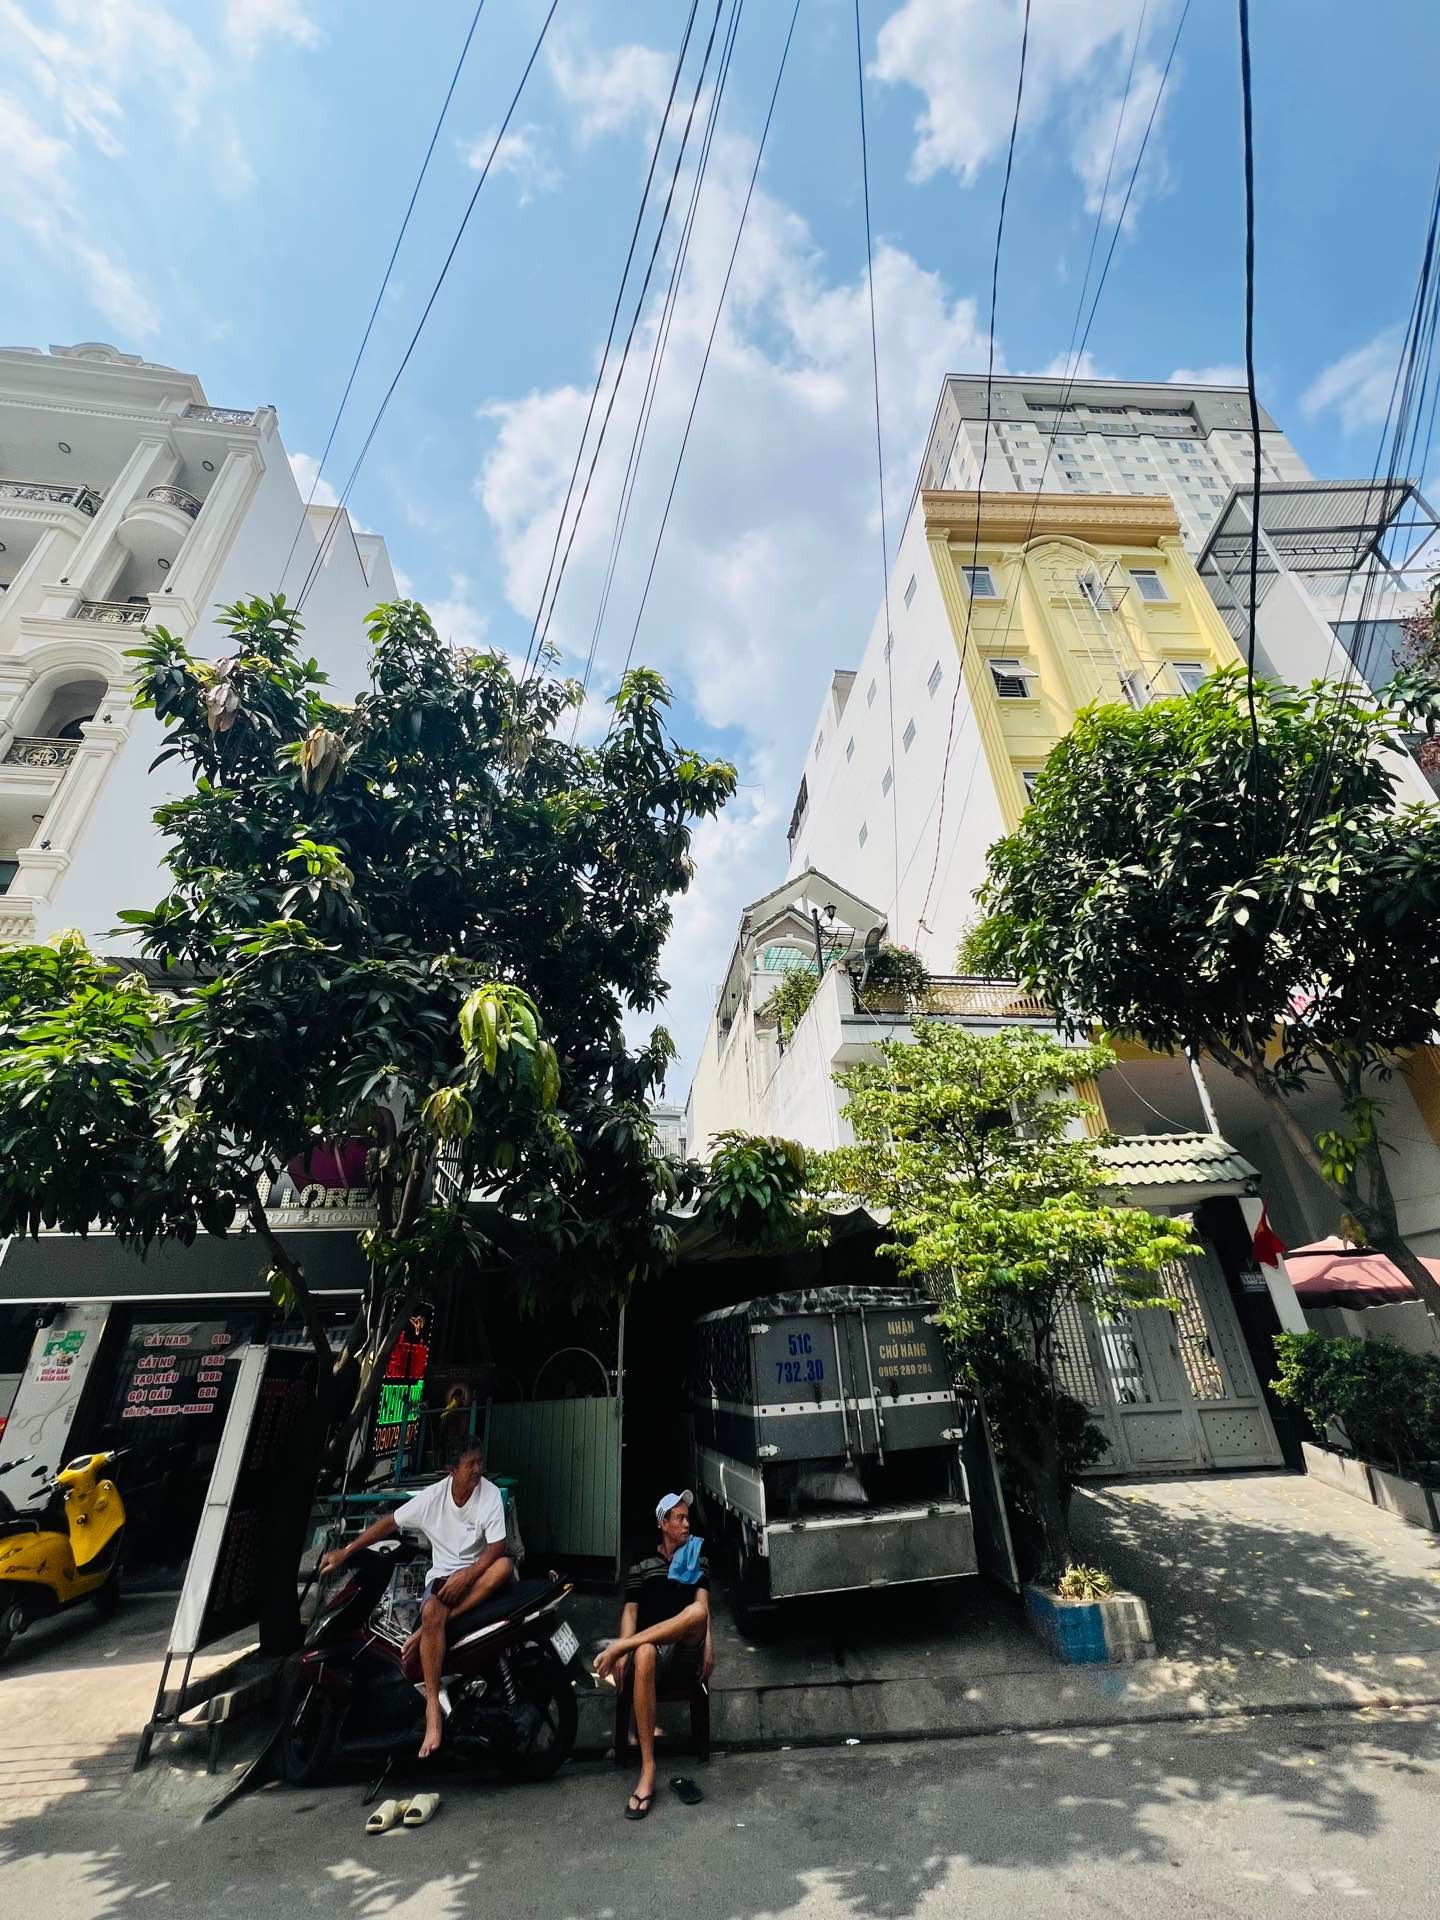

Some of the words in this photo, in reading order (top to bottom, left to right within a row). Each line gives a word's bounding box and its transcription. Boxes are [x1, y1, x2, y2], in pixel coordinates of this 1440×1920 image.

[887, 1320, 914, 1337] NHẬN
[788, 1333, 812, 1356] 51C
[879, 1339, 899, 1359] CHỞ
[900, 1341, 926, 1357] HÀNG
[138, 1355, 158, 1368] CẮT
[134, 1372, 154, 1386] TẠO
[183, 1404, 213, 1414] MASSAGE
